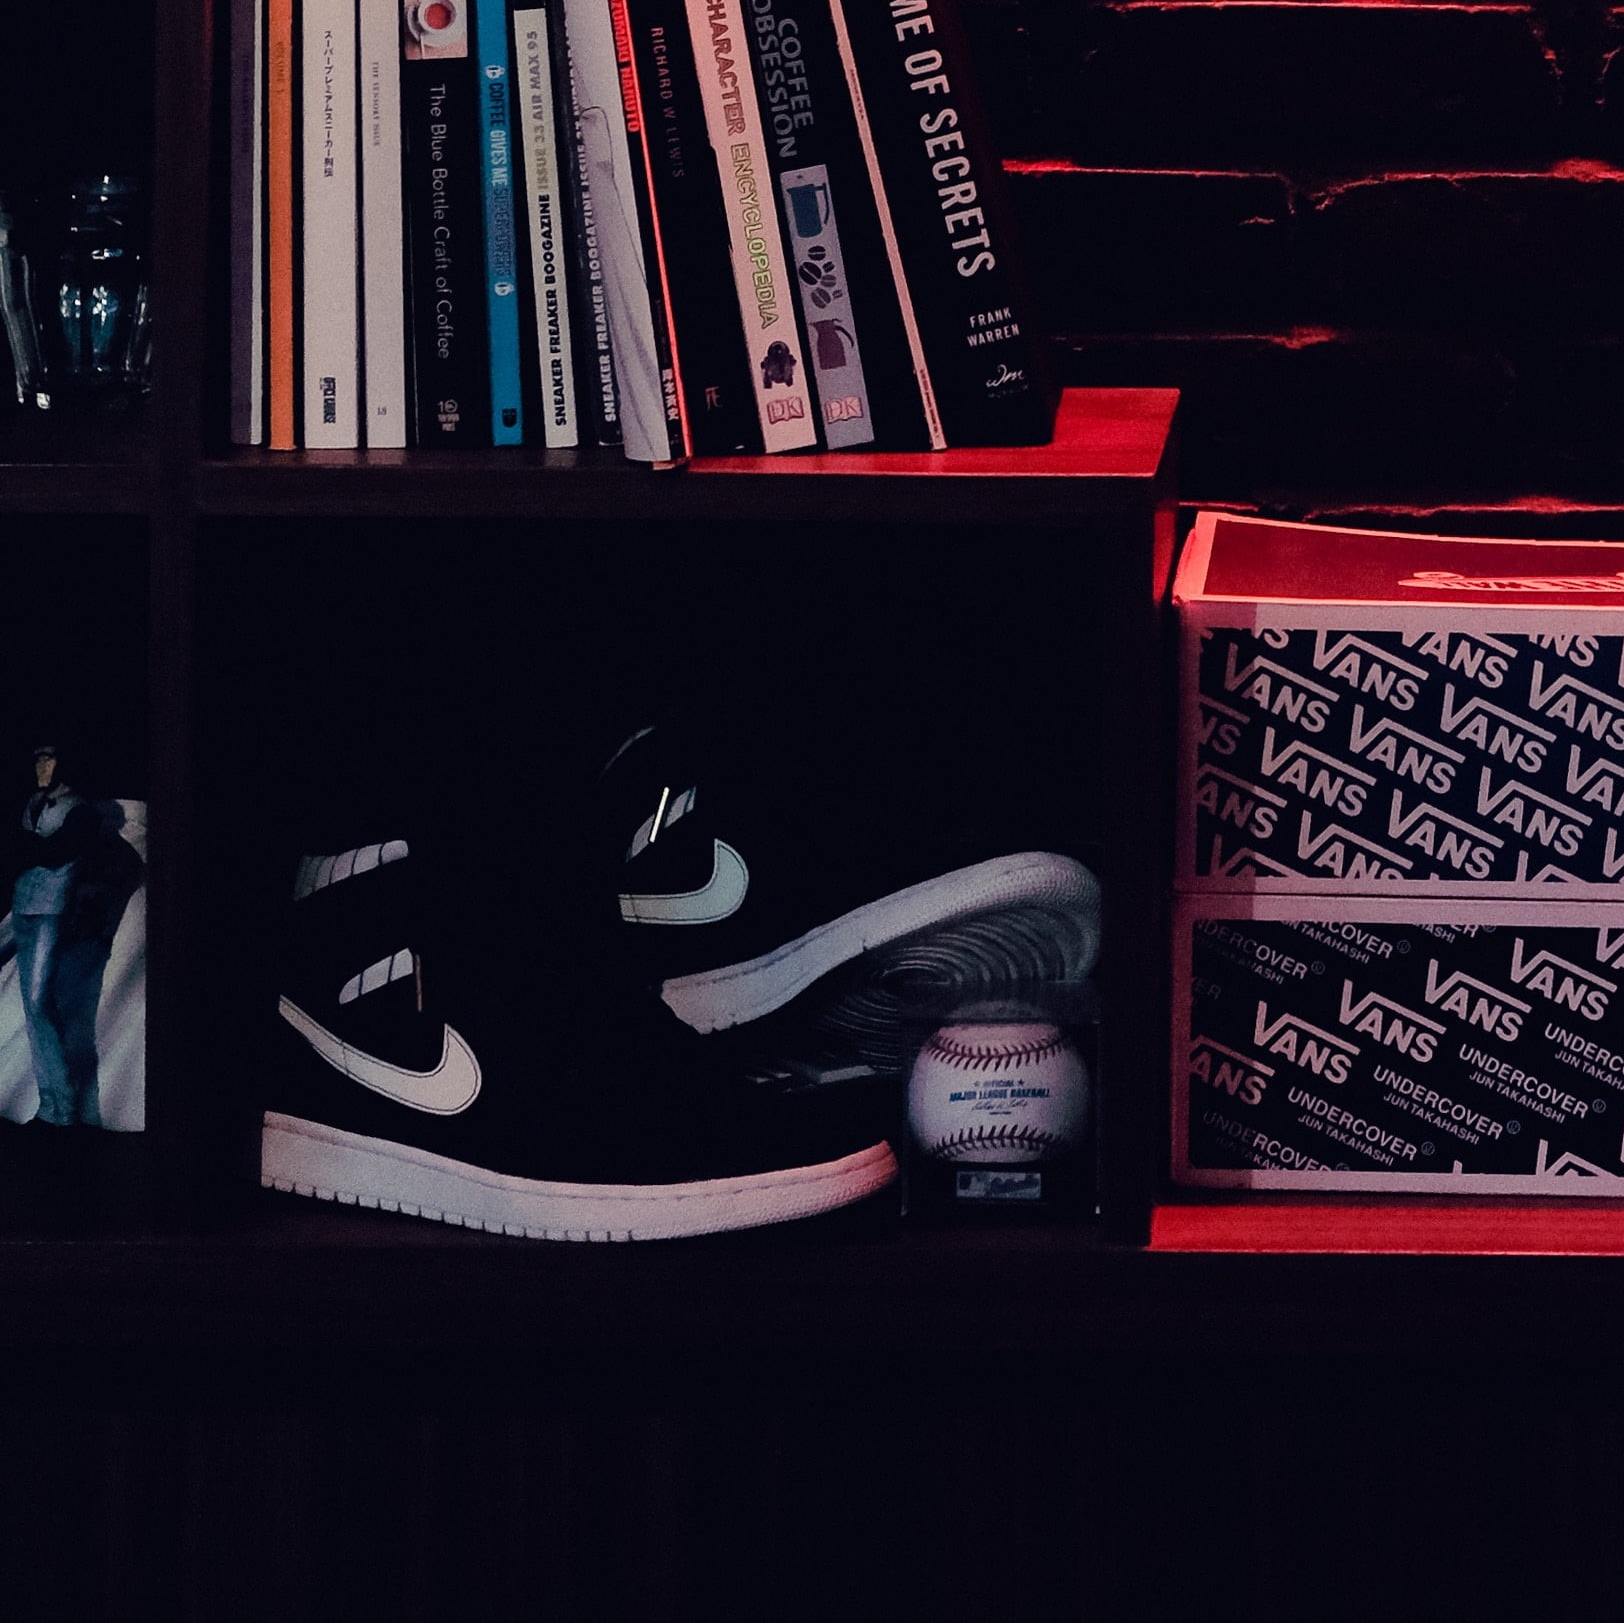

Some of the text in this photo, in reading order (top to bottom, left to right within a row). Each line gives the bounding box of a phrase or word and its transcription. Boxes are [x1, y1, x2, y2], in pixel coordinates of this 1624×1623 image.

[526, 31, 538, 51] 95
[528, 55, 540, 90] MAX
[778, 18, 814, 129] COFFEE
[903, 48, 950, 95] OF
[489, 82, 506, 126] COFFEE
[531, 95, 542, 120] AIR
[650, 26, 673, 100] RICHARD
[666, 126, 685, 178] LEWIS
[490, 130, 507, 165] GIVES
[491, 167, 508, 187] ME
[535, 148, 549, 189] ISSUE
[429, 83, 454, 360] The Blue Bottle Craft of Coffee
[919, 107, 996, 278] SECRETS
[541, 194, 557, 284] BOOGAZINE
[583, 191, 602, 281] BOOGAZINE
[730, 142, 779, 330] ENCYCLOPEDIA
[546, 289, 561, 354] FREAKER
[591, 285, 609, 350] FREAKER
[966, 323, 1020, 347] WARREN
[969, 306, 1013, 328] FRANK
[553, 359, 567, 426] SNEAKER
[600, 354, 617, 422] SNEAKER
[1224, 642, 1340, 733] VANS
[1313, 631, 1429, 711] VANS
[1350, 704, 1466, 795] VANS
[1440, 682, 1557, 773] VANS
[1261, 725, 1377, 817] VANS
[1388, 788, 1505, 879] VANS
[1476, 766, 1593, 857] VANS
[1424, 958, 1533, 1042] VANS
[1510, 937, 1618, 1021] VANS
[1253, 1000, 1361, 1085] VANS
[1339, 978, 1448, 1063] VANS
[1459, 1043, 1589, 1119] UNDERCOVER
[1555, 1051, 1581, 1067] JUN
[1287, 1085, 1418, 1161] UNDERCOVER
[1372, 1064, 1504, 1140] UNDERCOVER
[1383, 1093, 1480, 1146] JUN TAKAHASHI
[1469, 1072, 1566, 1125] JUN TAKAHASHI
[1298, 1114, 1324, 1131] JUN
[1325, 1126, 1394, 1167] TAKAHASHI
